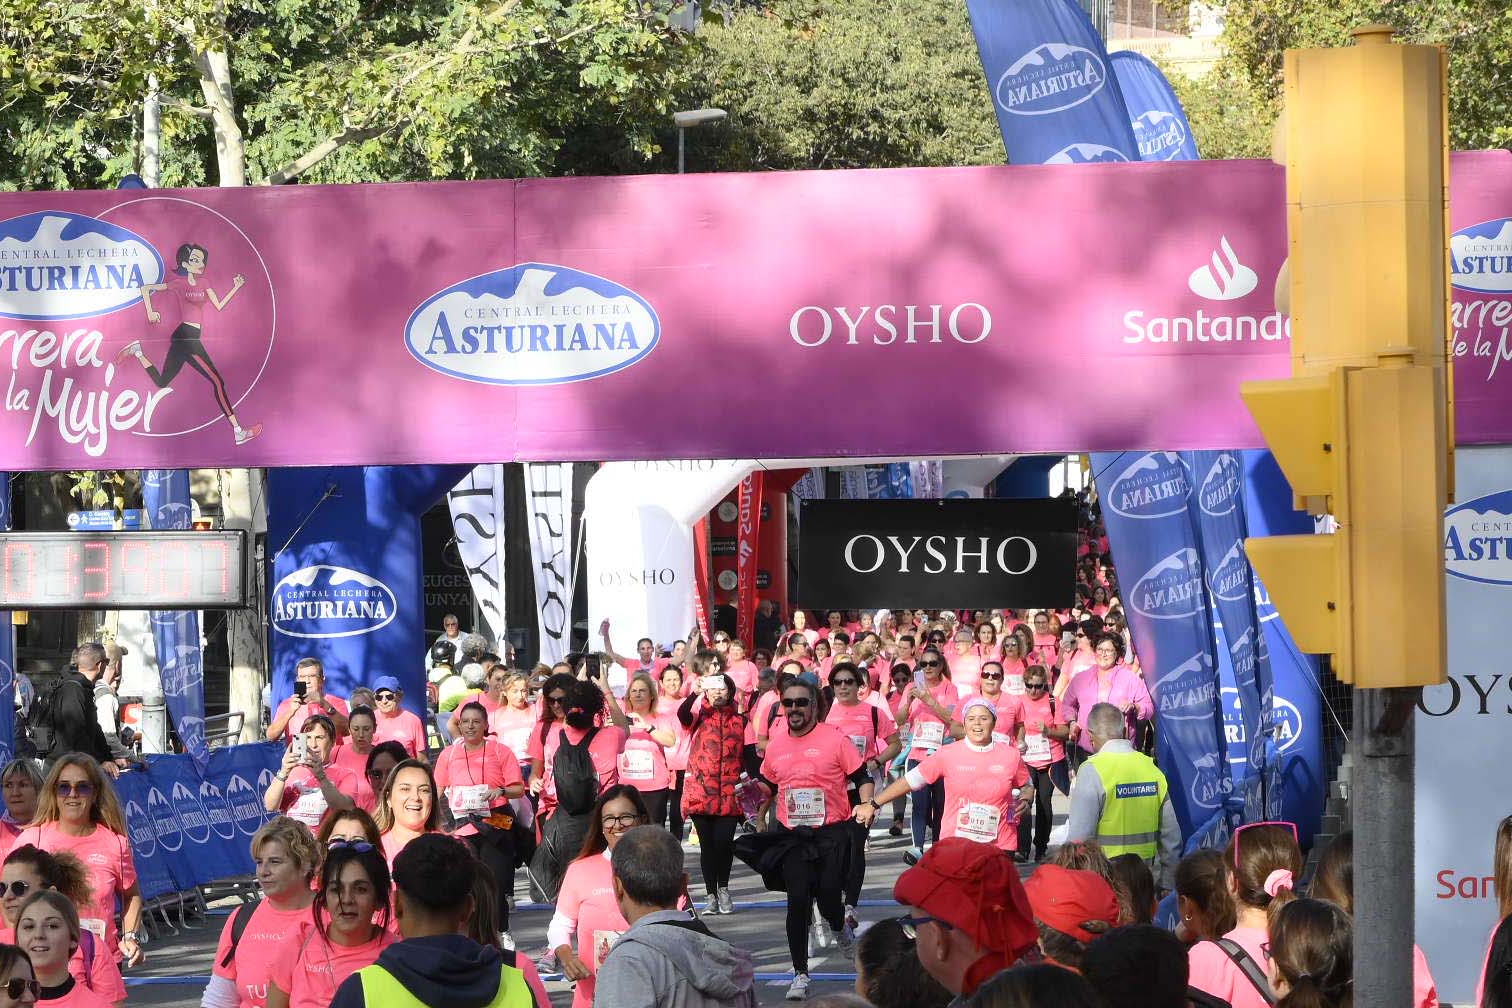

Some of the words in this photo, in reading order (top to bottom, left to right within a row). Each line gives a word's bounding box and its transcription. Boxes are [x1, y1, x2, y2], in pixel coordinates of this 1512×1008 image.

[67, 246, 139, 258] LECHERA
[464, 305, 543, 319] CENTRAL
[551, 303, 633, 317] LECHERA
[424, 310, 640, 355] ASTURIANA
[789, 303, 992, 347] OYSHO
[1122, 309, 1291, 344] Santand
[5, 370, 29, 412] la
[25, 363, 173, 456] Mujer
[844, 534, 1038, 576] OYSHO
[275, 594, 387, 621] ASTURIANA
[287, 589, 329, 599] CENTRAL
[333, 589, 383, 599] LECHERA
[1116, 784, 1158, 796] VOLUNTARIS
[246, 984, 268, 999] TU
